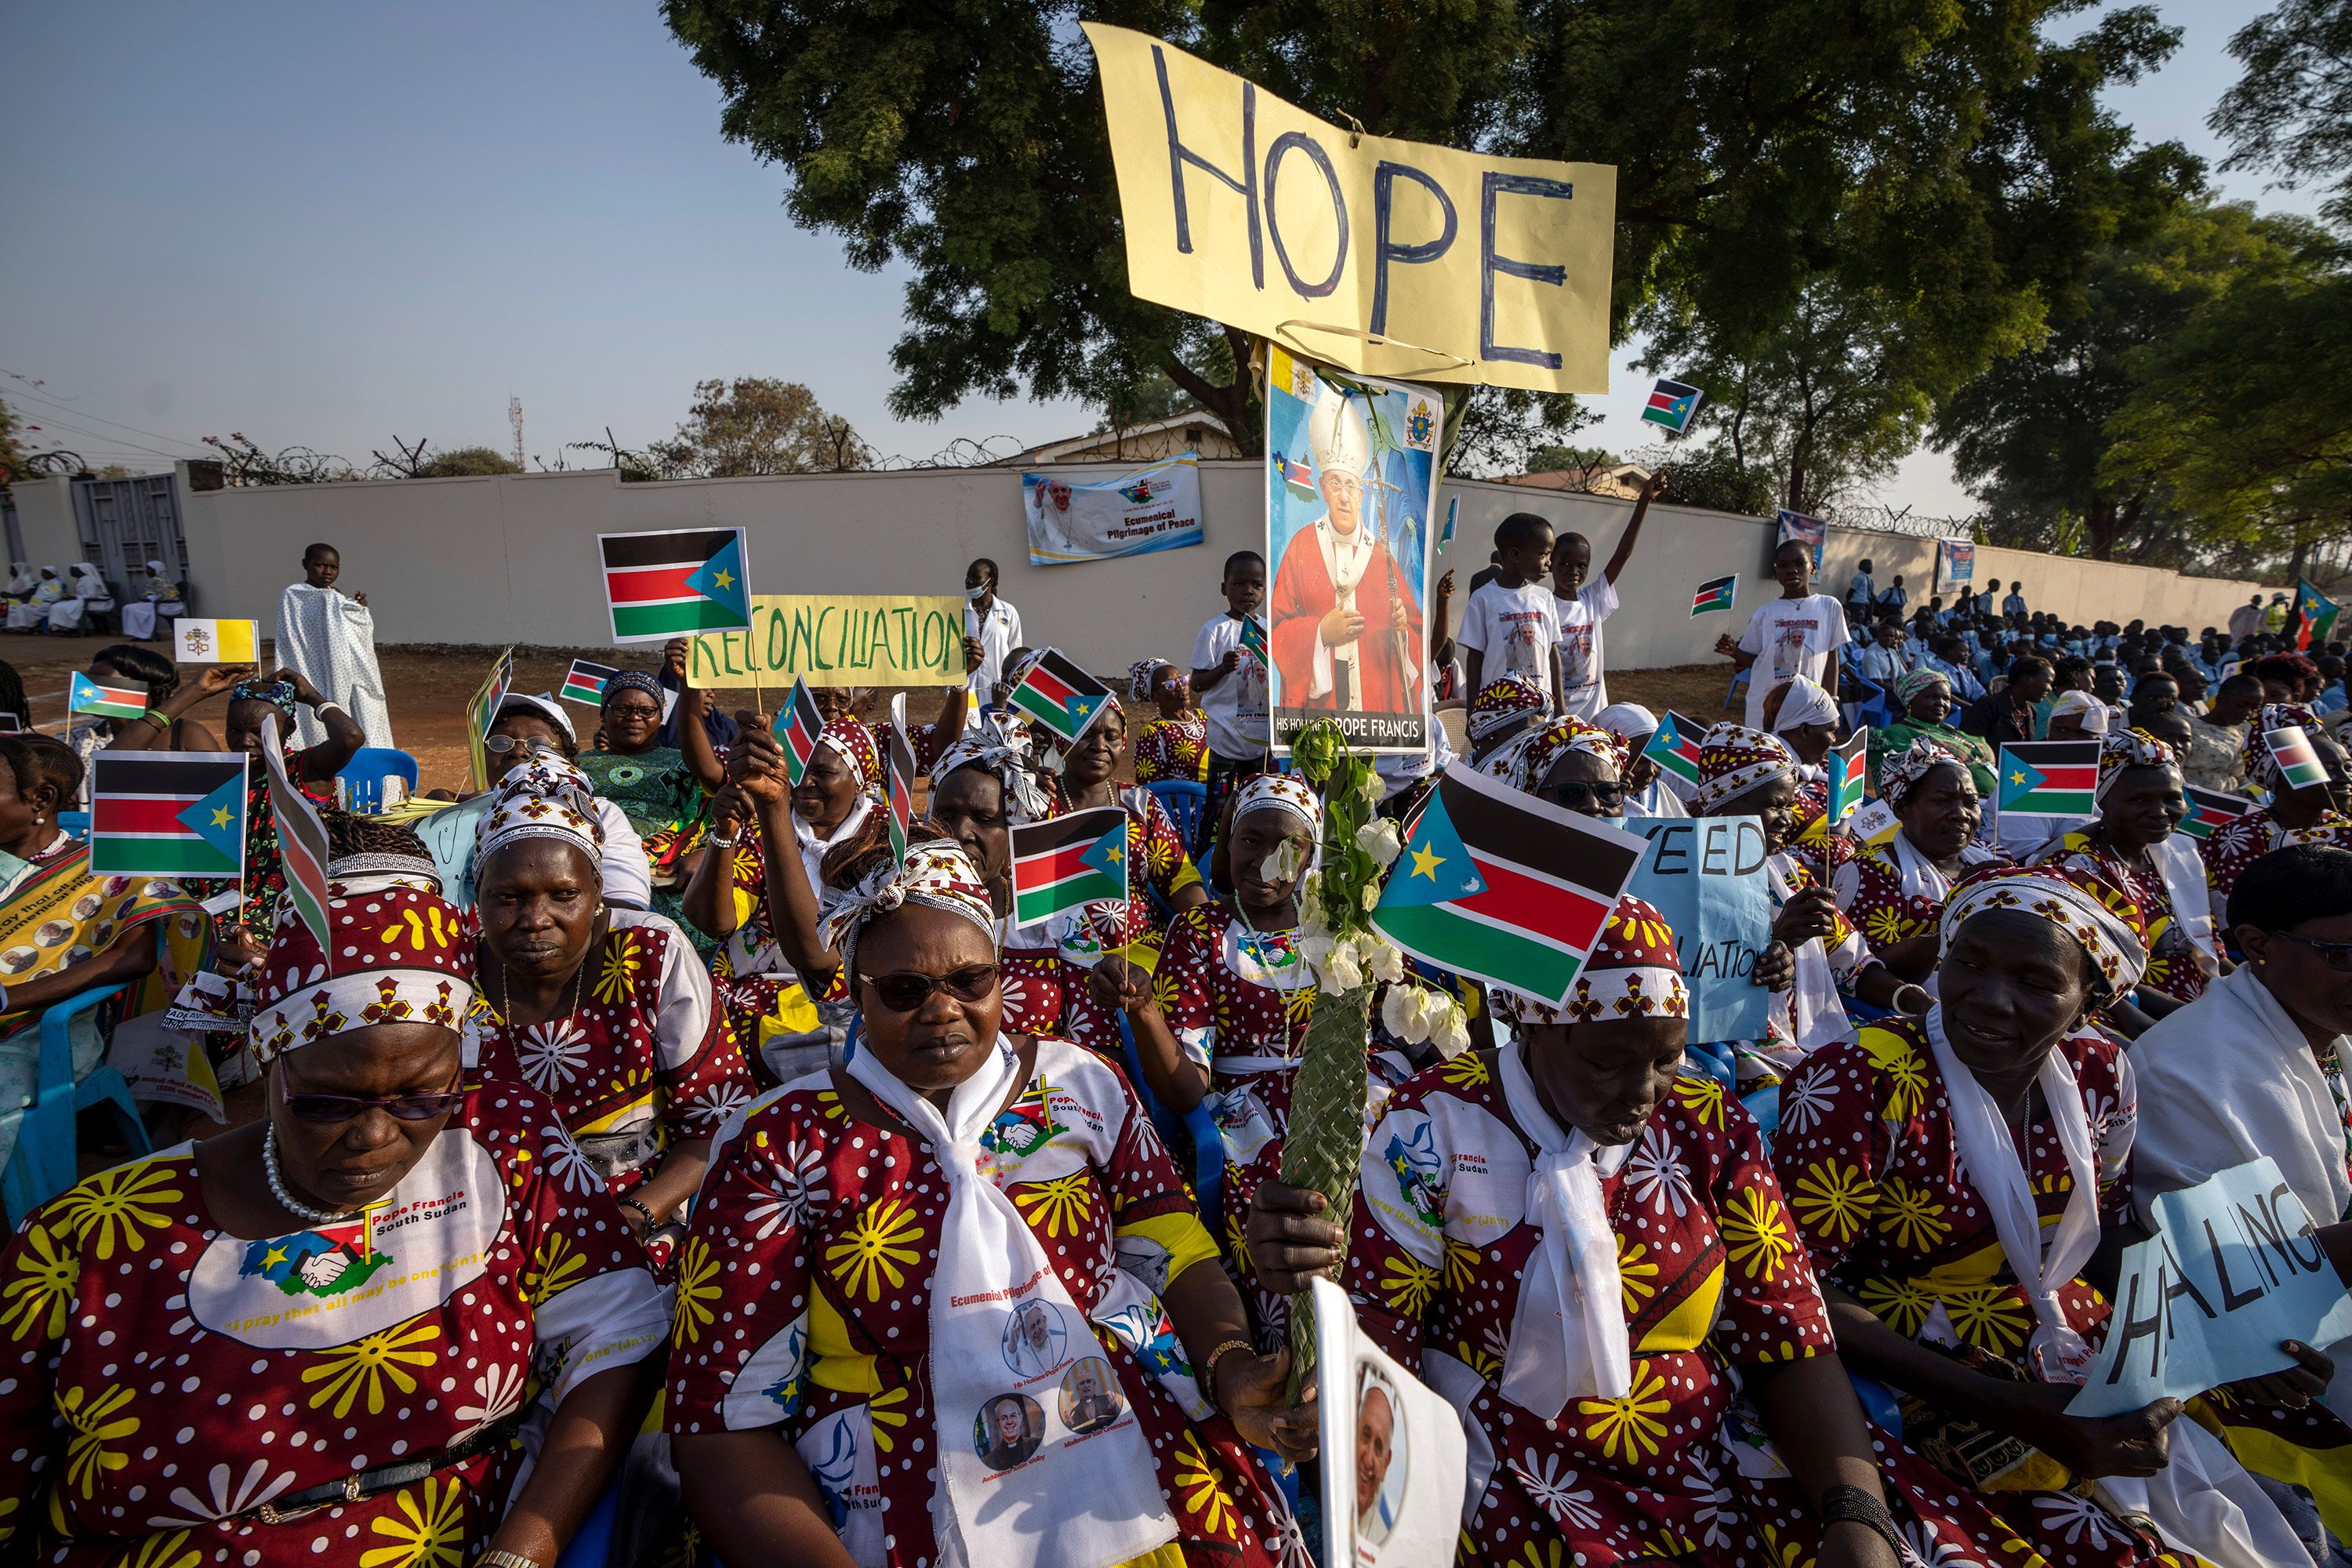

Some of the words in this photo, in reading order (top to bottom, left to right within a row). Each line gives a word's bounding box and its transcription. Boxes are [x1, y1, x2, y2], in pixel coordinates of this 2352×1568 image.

[1152, 44, 1573, 369] HOPE
[1107, 524, 1154, 539] Pilgrimage
[1156, 521, 1166, 532] of
[1168, 517, 1195, 529] Peace
[1124, 509, 1175, 526] Ecumenical
[1276, 717, 1289, 731] HIS
[1334, 717, 1367, 736] POPE
[1371, 719, 1419, 738] FRANCIS
[554, 829, 576, 839] NIGERIA
[21, 894, 50, 913] that
[53, 884, 70, 895] all
[926, 892, 956, 906] ANGLOR
[958, 902, 973, 914] WAX
[1458, 1163, 1488, 1174] Sudan
[372, 1206, 408, 1225] Pope
[412, 1190, 464, 1213] Francis
[376, 1214, 422, 1236] South
[423, 1200, 467, 1221] Sudan
[1043, 1264, 1051, 1276] of
[243, 1313, 281, 1332] pray
[284, 1304, 319, 1320] that
[325, 1297, 347, 1312] all
[351, 1283, 384, 1303] may
[387, 1272, 407, 1287] be
[1014, 1381, 1024, 1390] His
